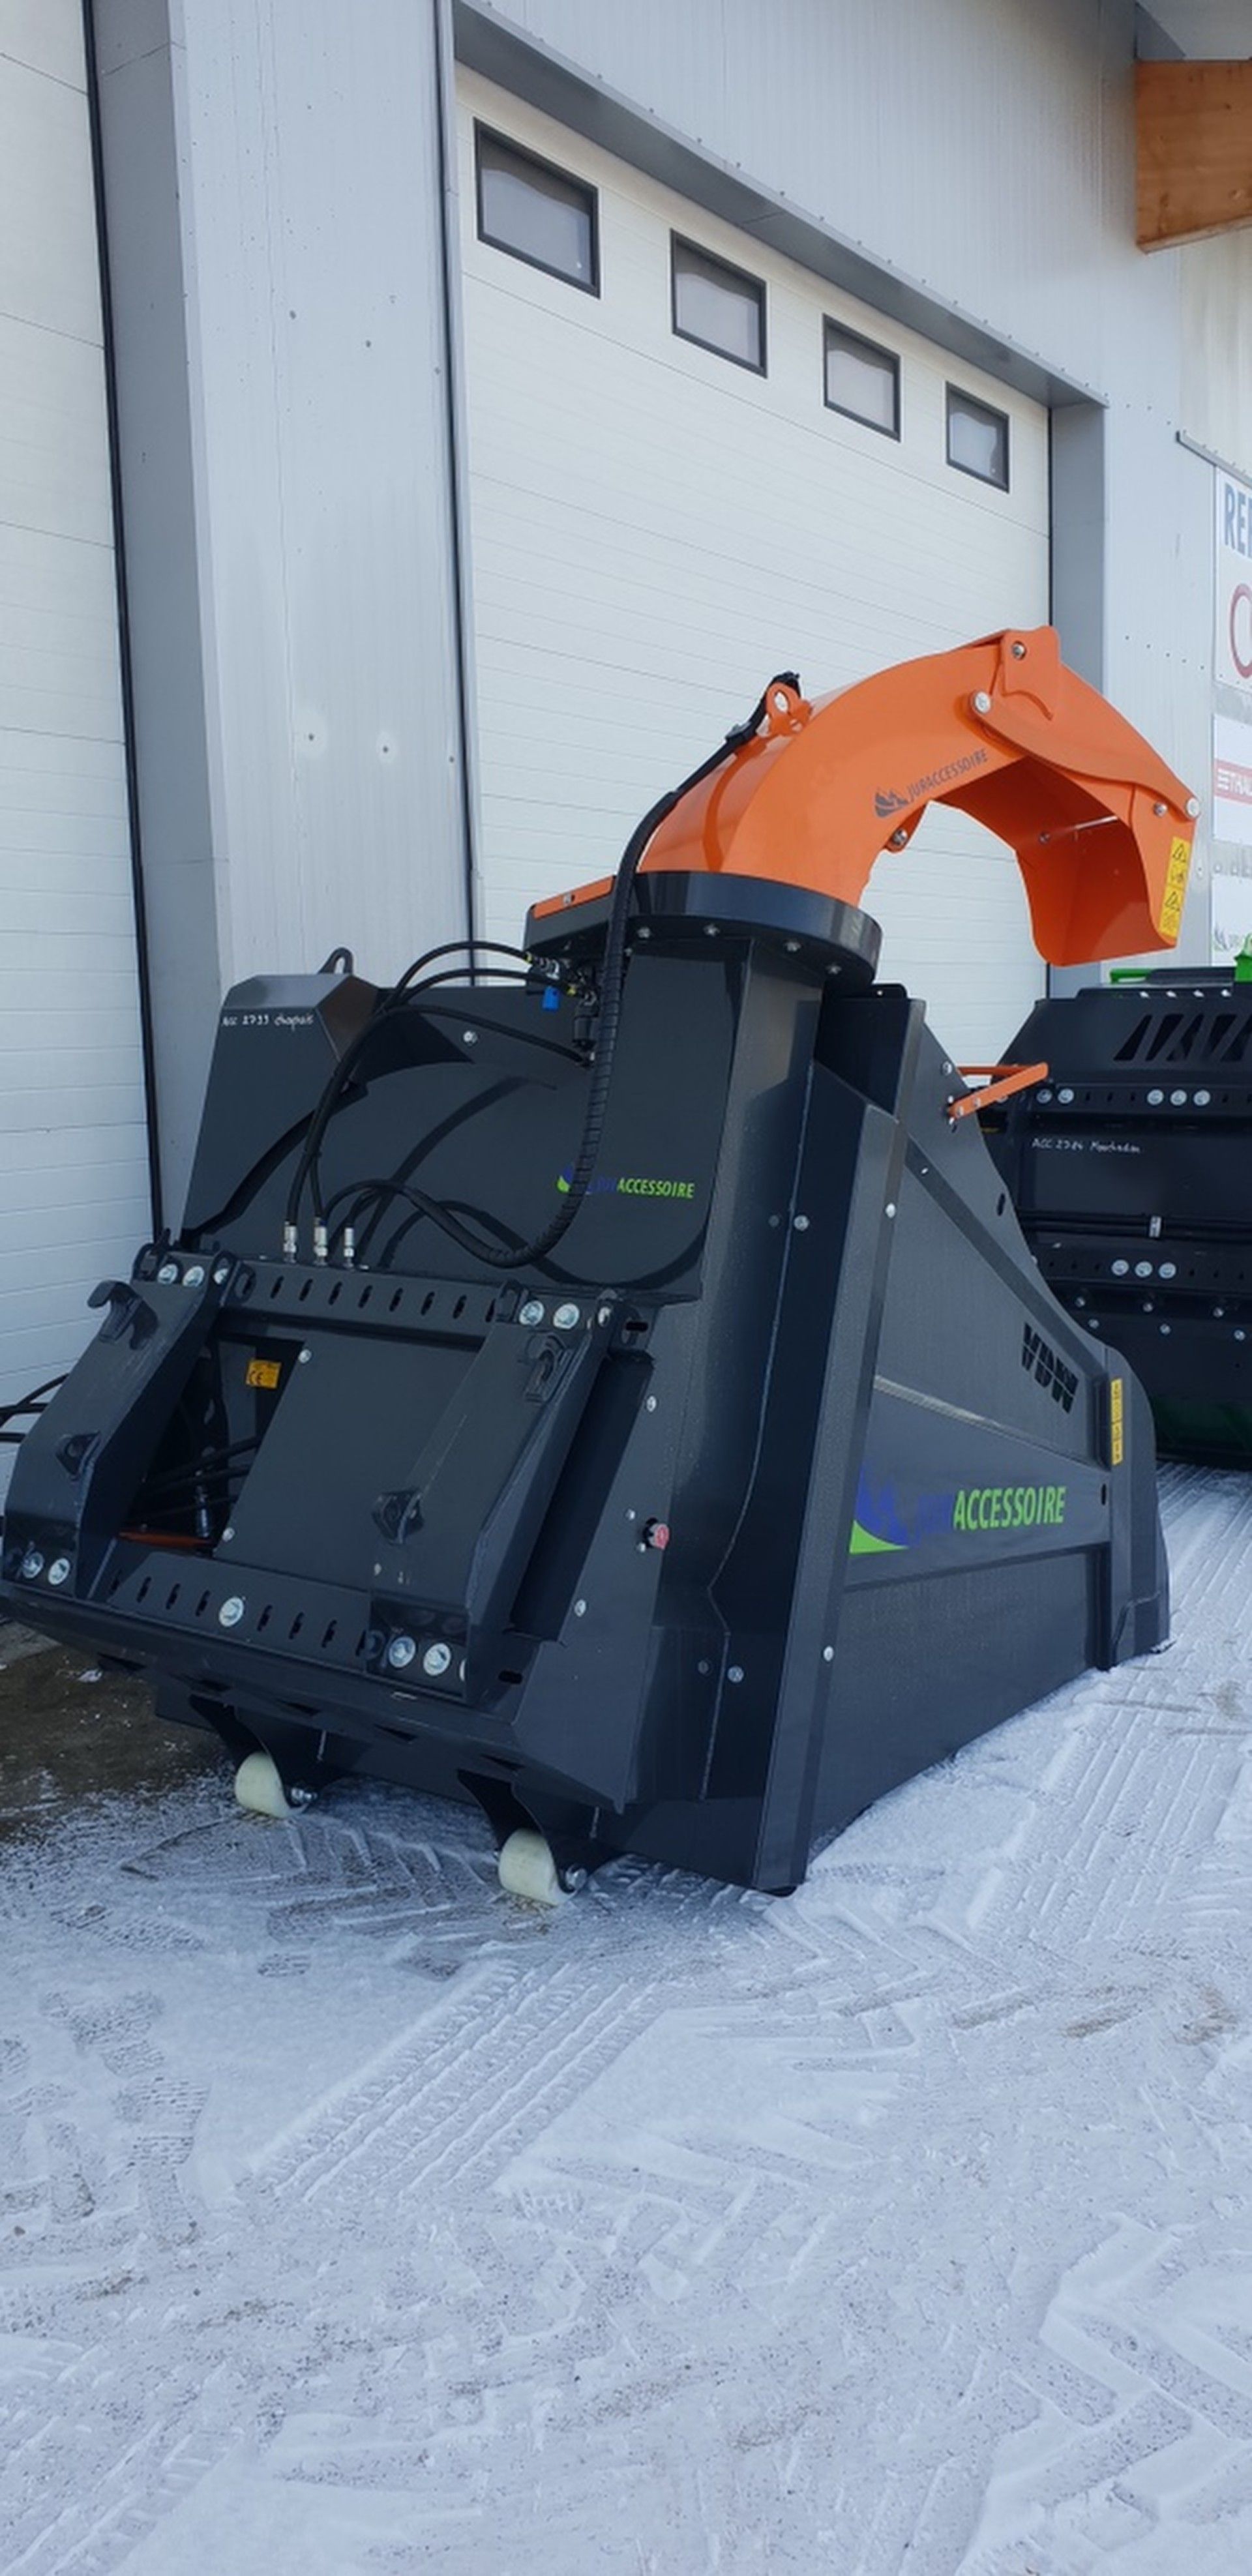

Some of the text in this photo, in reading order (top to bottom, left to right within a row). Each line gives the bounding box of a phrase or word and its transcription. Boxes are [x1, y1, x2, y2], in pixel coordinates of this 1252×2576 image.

[906, 748, 988, 803] JURACCESSOIRE
[592, 1176, 695, 1199] ACCESSOIRE
[914, 1486, 1067, 1543] ACCESSOIRE
